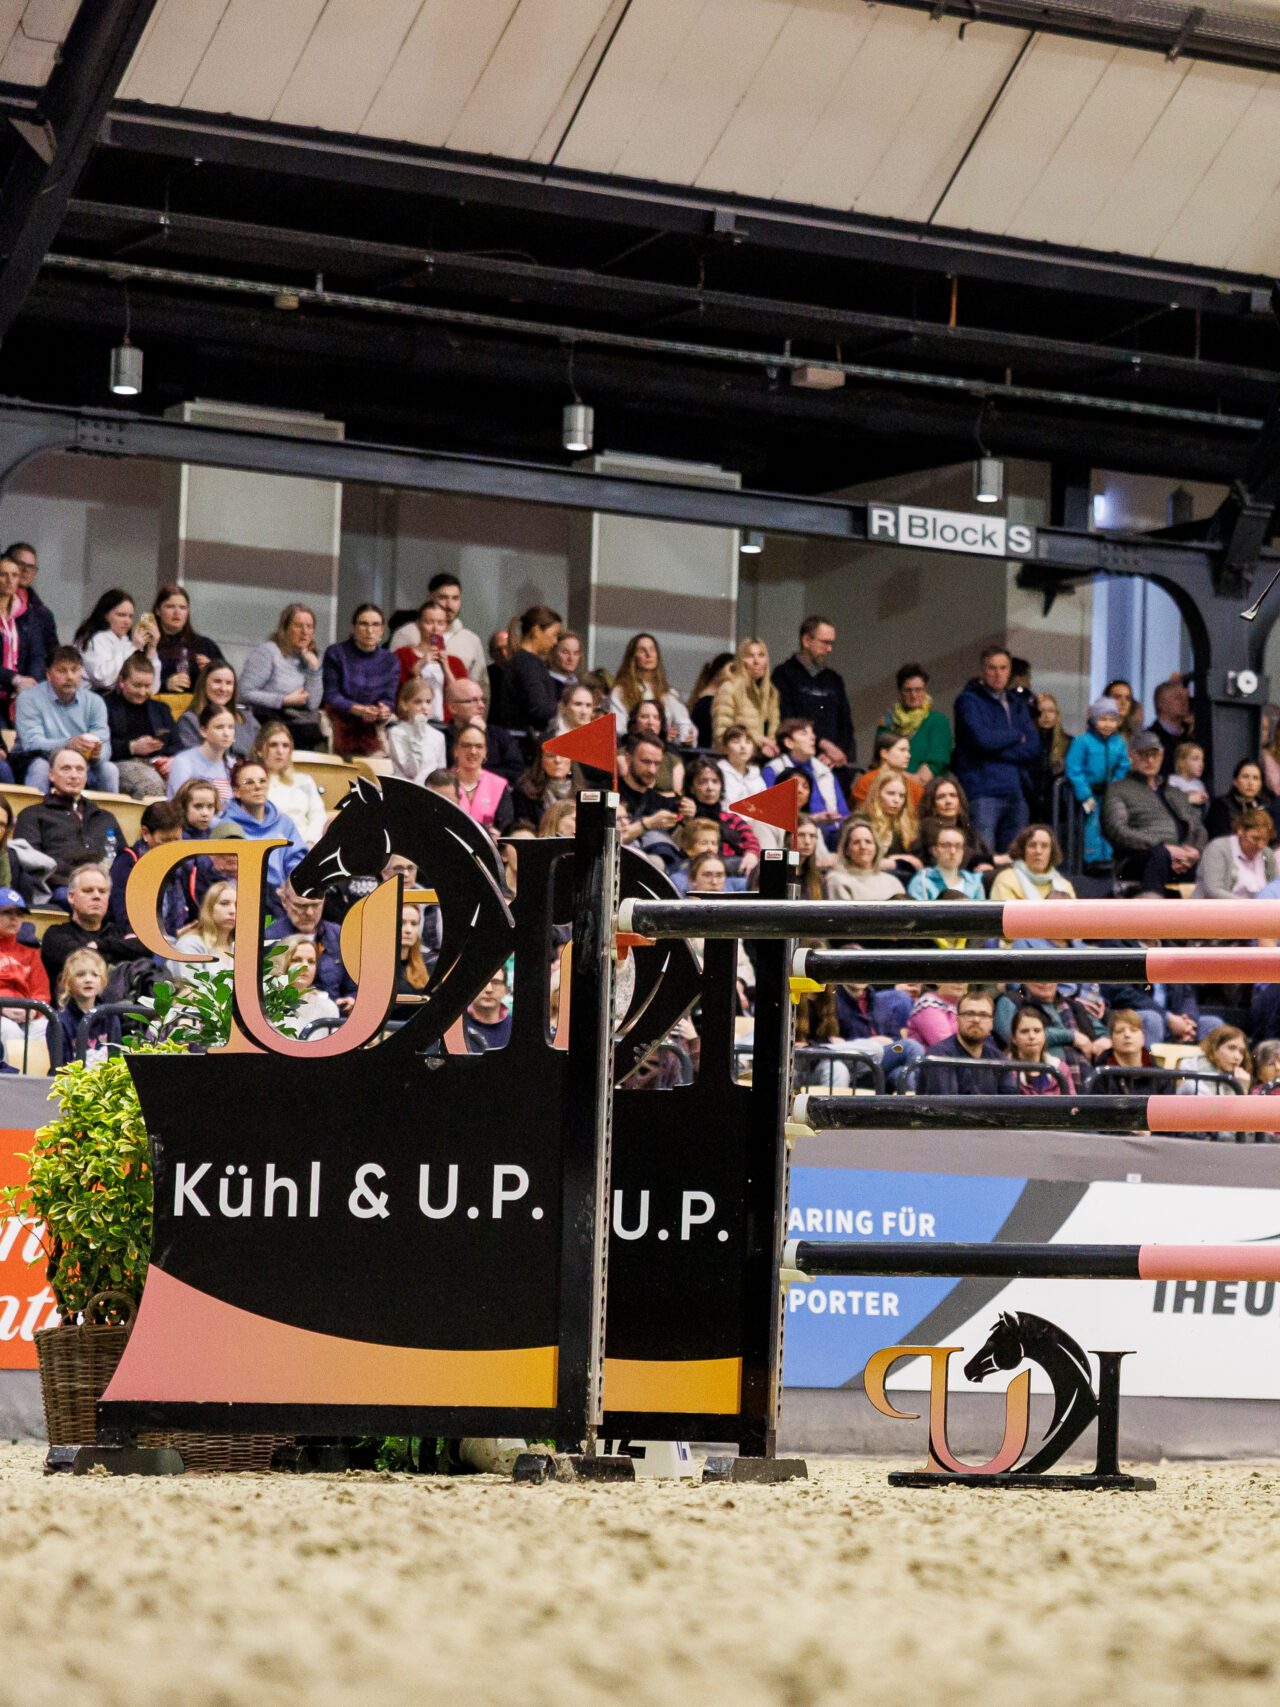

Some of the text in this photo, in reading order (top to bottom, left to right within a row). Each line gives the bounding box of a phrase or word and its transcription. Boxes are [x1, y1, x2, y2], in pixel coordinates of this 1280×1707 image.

[871, 508, 1032, 553] R Block S
[173, 1161, 545, 1220] Kühl & U.P.
[612, 1189, 730, 1242] U.P.
[882, 1206, 936, 1238] FÜR
[785, 1288, 900, 1317] PORTER
